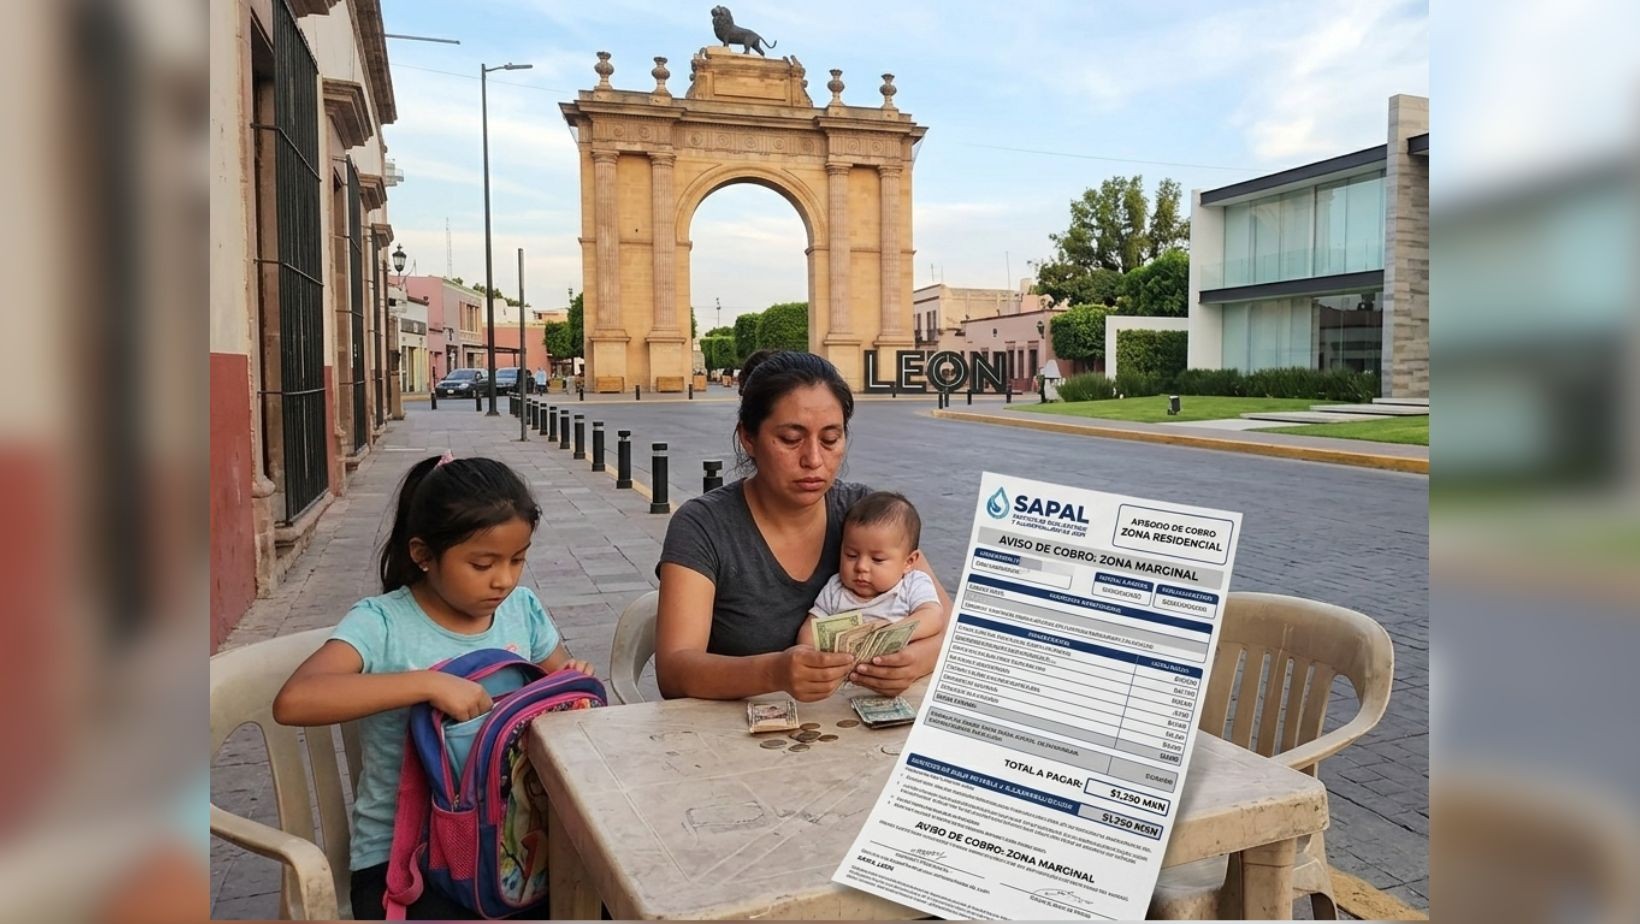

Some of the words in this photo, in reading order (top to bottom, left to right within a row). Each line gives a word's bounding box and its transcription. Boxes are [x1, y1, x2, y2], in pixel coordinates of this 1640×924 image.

[864, 350, 1007, 394] LEON
[1014, 495, 1089, 524] SAPAL
[1121, 527, 1150, 541] ZONA
[1152, 532, 1222, 552] RESIDENCIAL
[1171, 524, 1183, 533] DE
[999, 535, 1033, 550] AVISO
[1035, 542, 1052, 554] DE
[1053, 546, 1097, 563] COBRO:
[1100, 554, 1133, 570] ZONA
[1135, 561, 1199, 582] MARGINAL
[1004, 758, 1035, 775] TOTAL
[1036, 769, 1044, 778] A
[948, 831, 963, 842] DE
[1006, 849, 1037, 866] ZONA
[1038, 859, 1095, 884] MARGINAL
